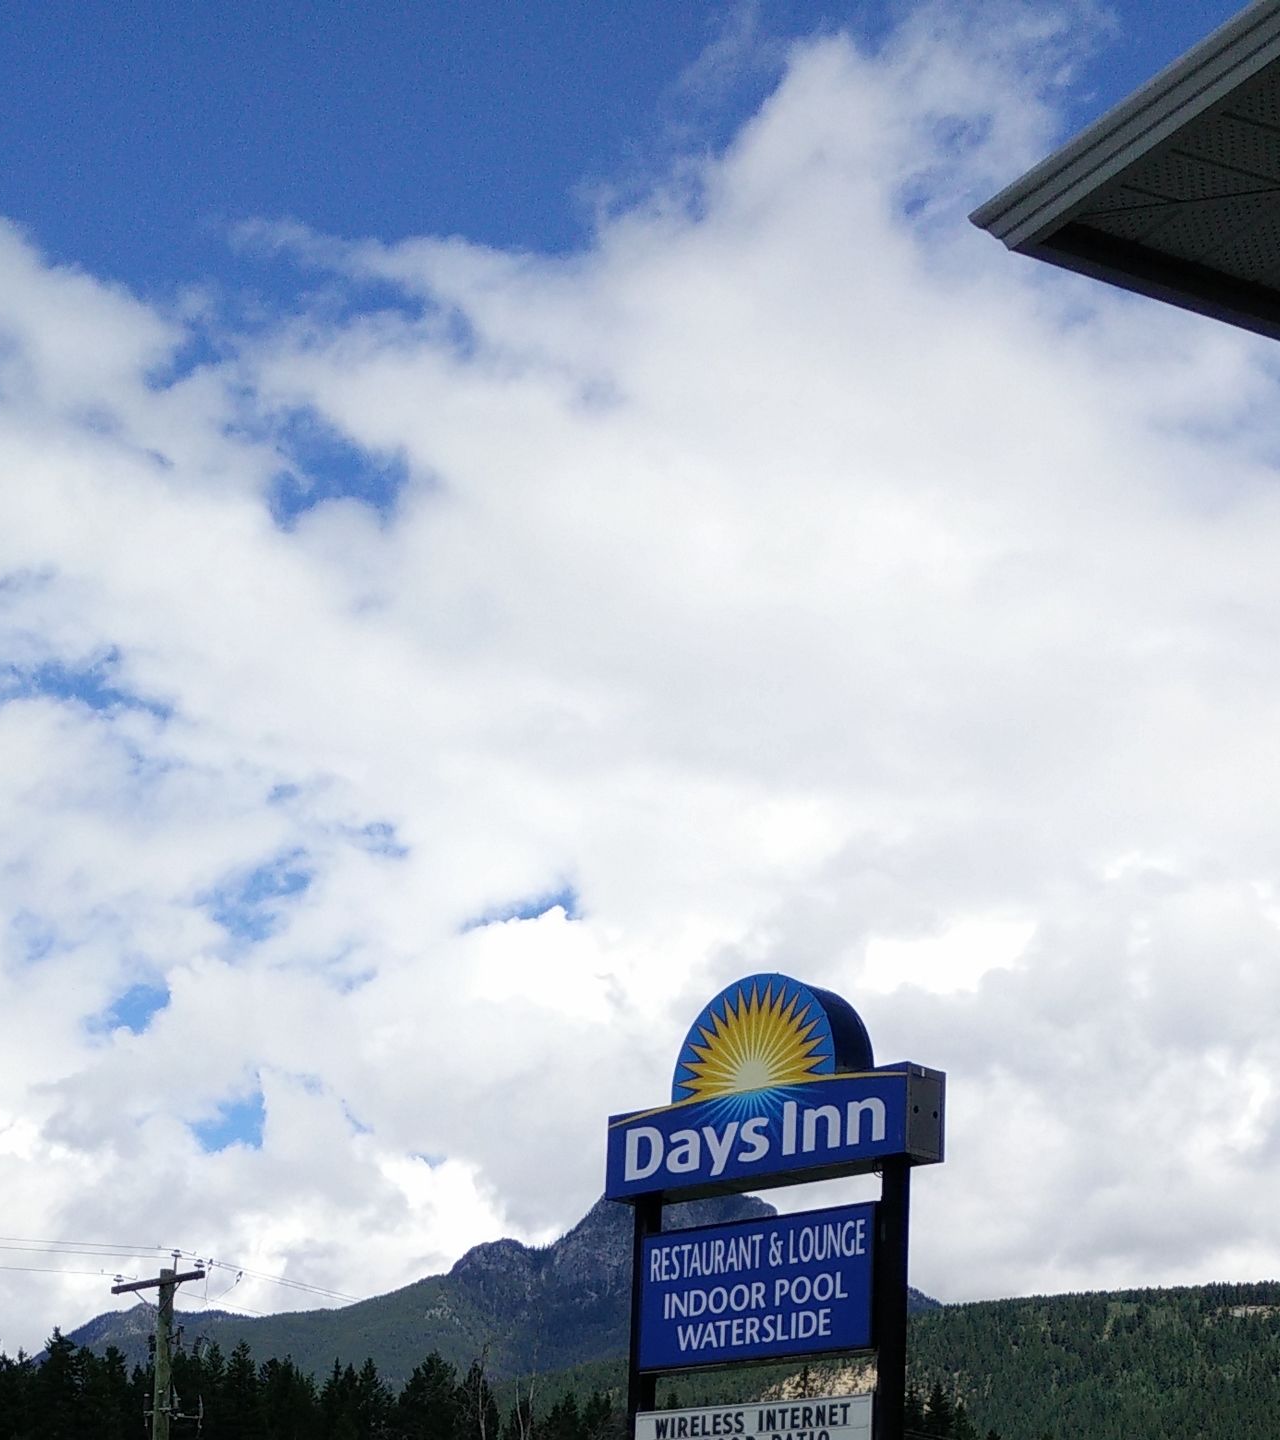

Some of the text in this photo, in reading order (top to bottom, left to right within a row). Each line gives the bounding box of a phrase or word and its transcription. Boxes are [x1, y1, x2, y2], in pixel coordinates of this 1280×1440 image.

[624, 1097, 887, 1182] Days Inn
[650, 1218, 866, 1283] RESTAURANT & LOUNGE
[663, 1271, 849, 1320] INDOOR POOL
[676, 1308, 832, 1352] WATERSLIDE
[654, 1402, 851, 1440] WIRELESS INTERNET
